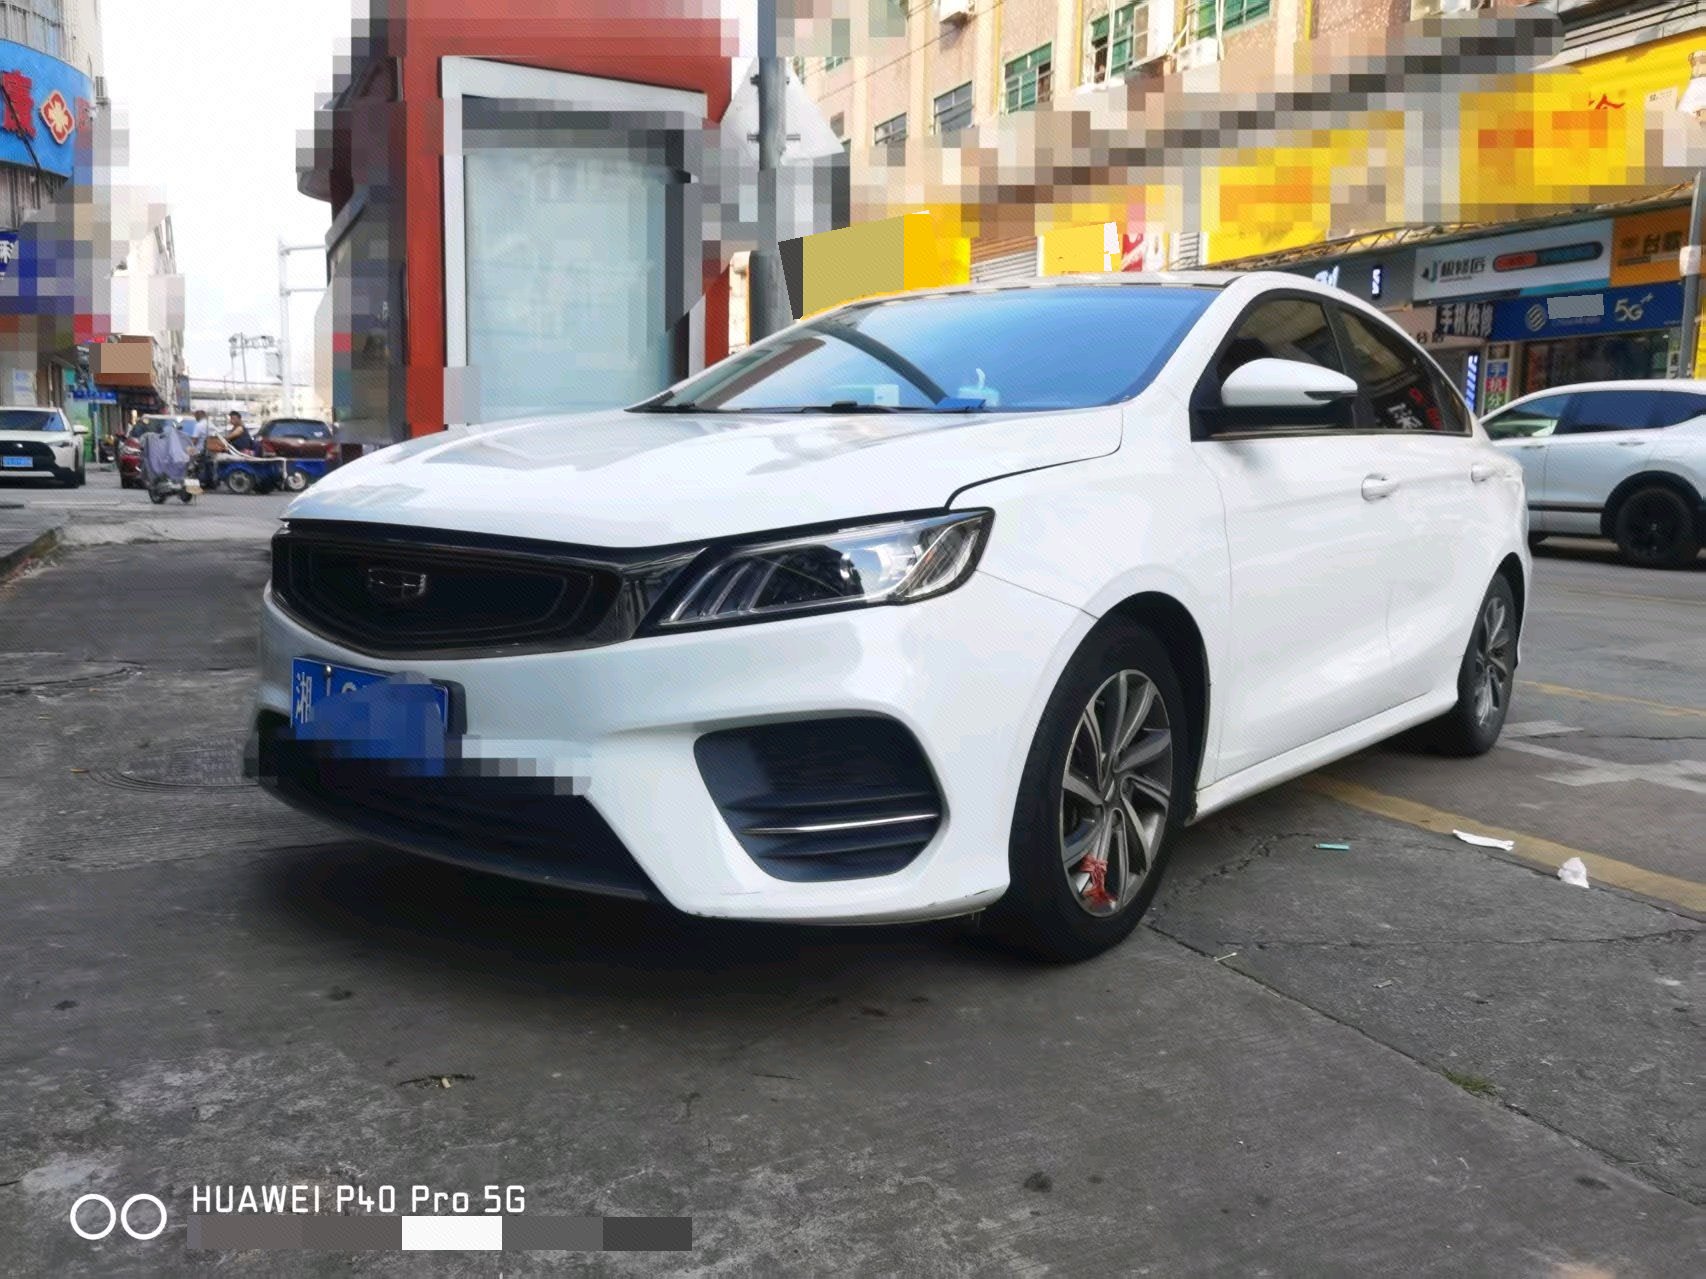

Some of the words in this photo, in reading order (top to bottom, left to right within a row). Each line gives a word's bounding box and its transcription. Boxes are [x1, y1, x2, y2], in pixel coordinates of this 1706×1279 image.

[1439, 302, 1495, 338] 手机快修
[1486, 361, 1508, 413] 手机分
